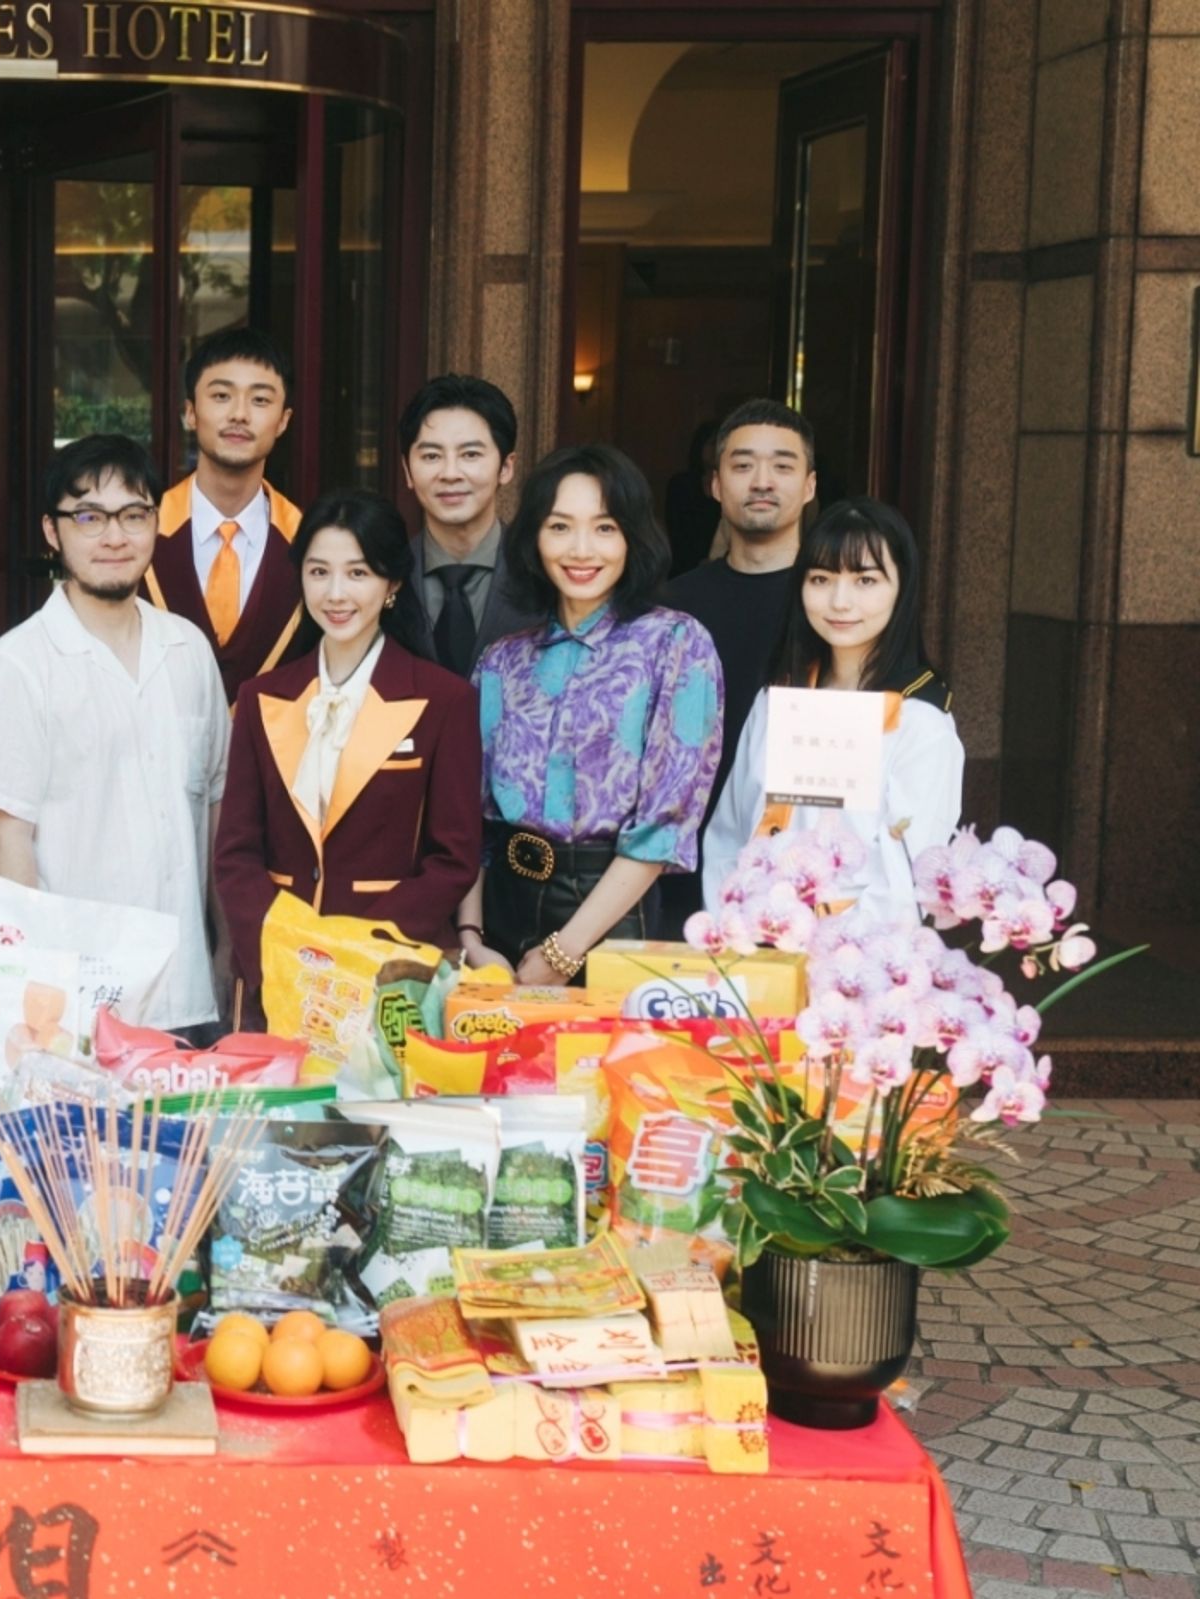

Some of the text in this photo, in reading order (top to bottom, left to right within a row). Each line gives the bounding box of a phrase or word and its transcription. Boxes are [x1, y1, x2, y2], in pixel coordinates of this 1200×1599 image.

[82, 3, 269, 67] HOTEL
[453, 1008, 521, 1038] Cheetos
[238, 1167, 308, 1206] 海苔
